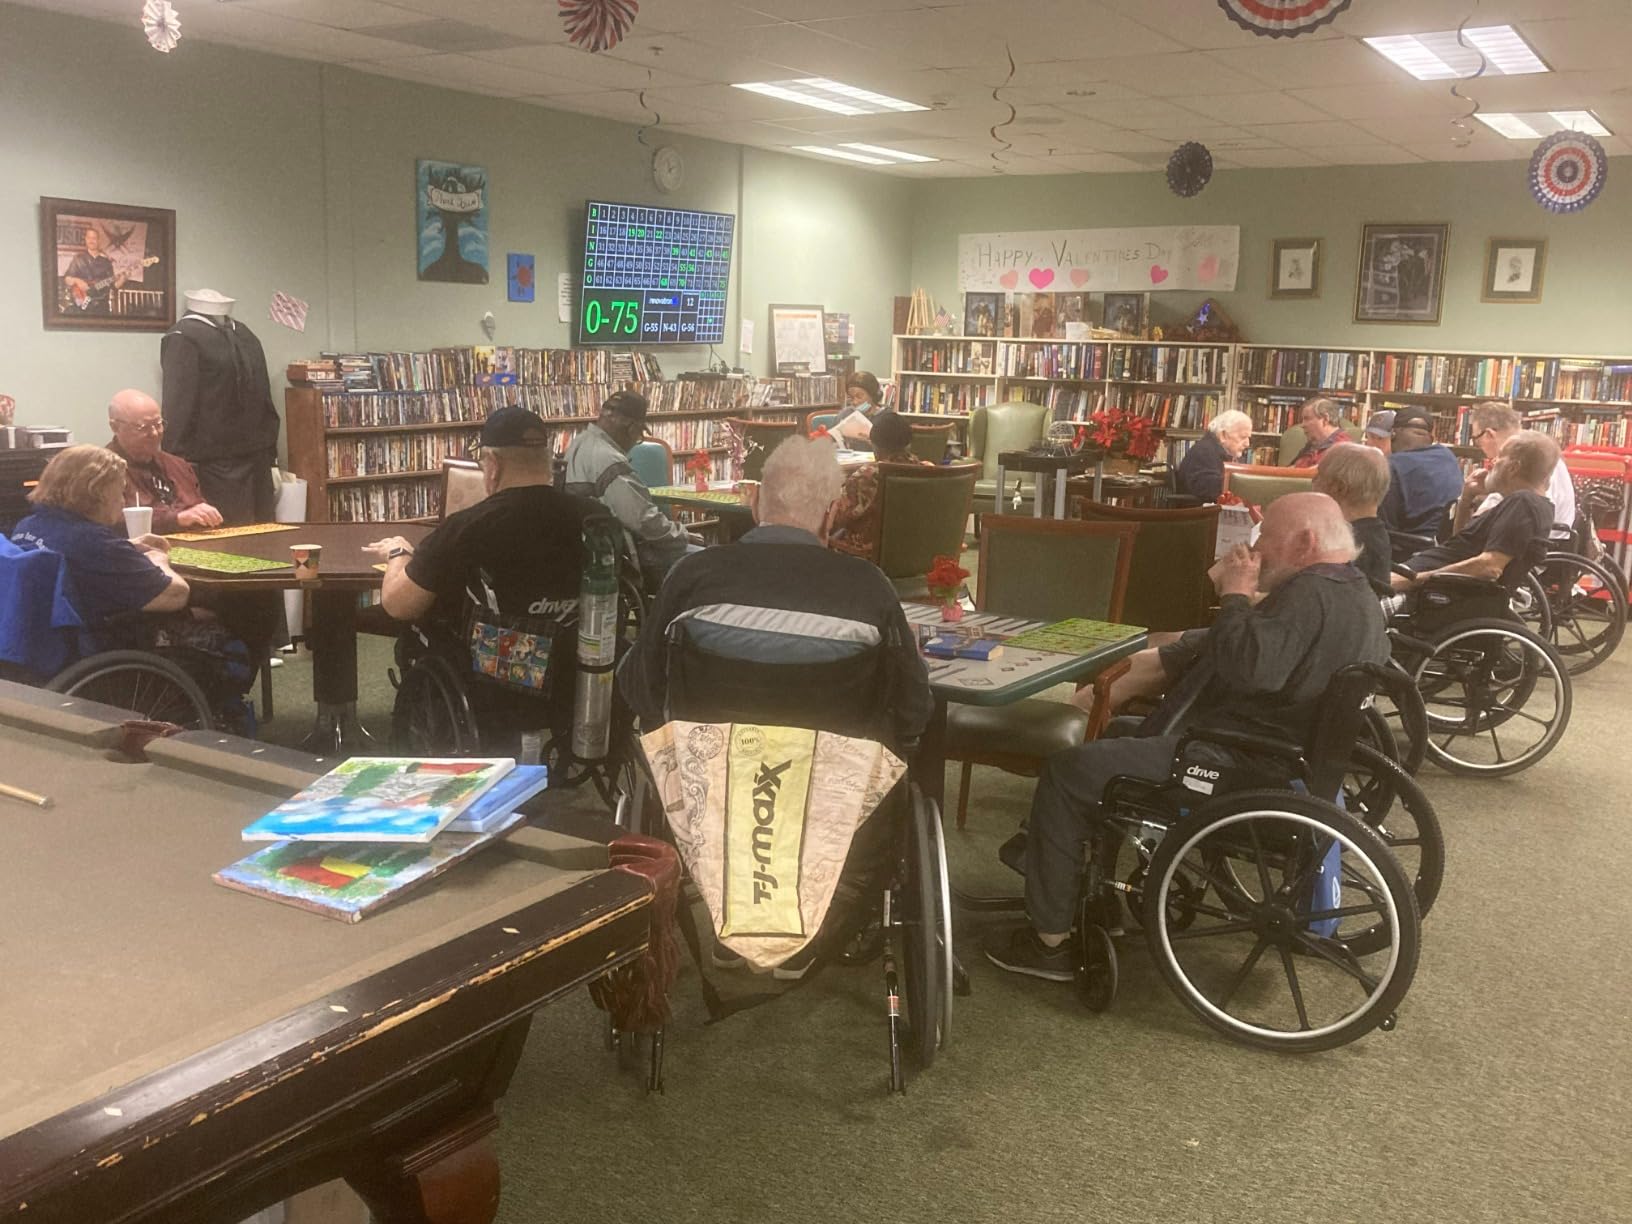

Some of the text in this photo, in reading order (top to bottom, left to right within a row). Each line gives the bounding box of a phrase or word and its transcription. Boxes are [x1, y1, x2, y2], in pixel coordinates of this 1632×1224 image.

[686, 298, 694, 306] 12
[644, 322, 658, 332] G-55
[663, 322, 677, 332] N-43
[682, 322, 695, 332] G-56
[1186, 766, 1220, 780] drive
